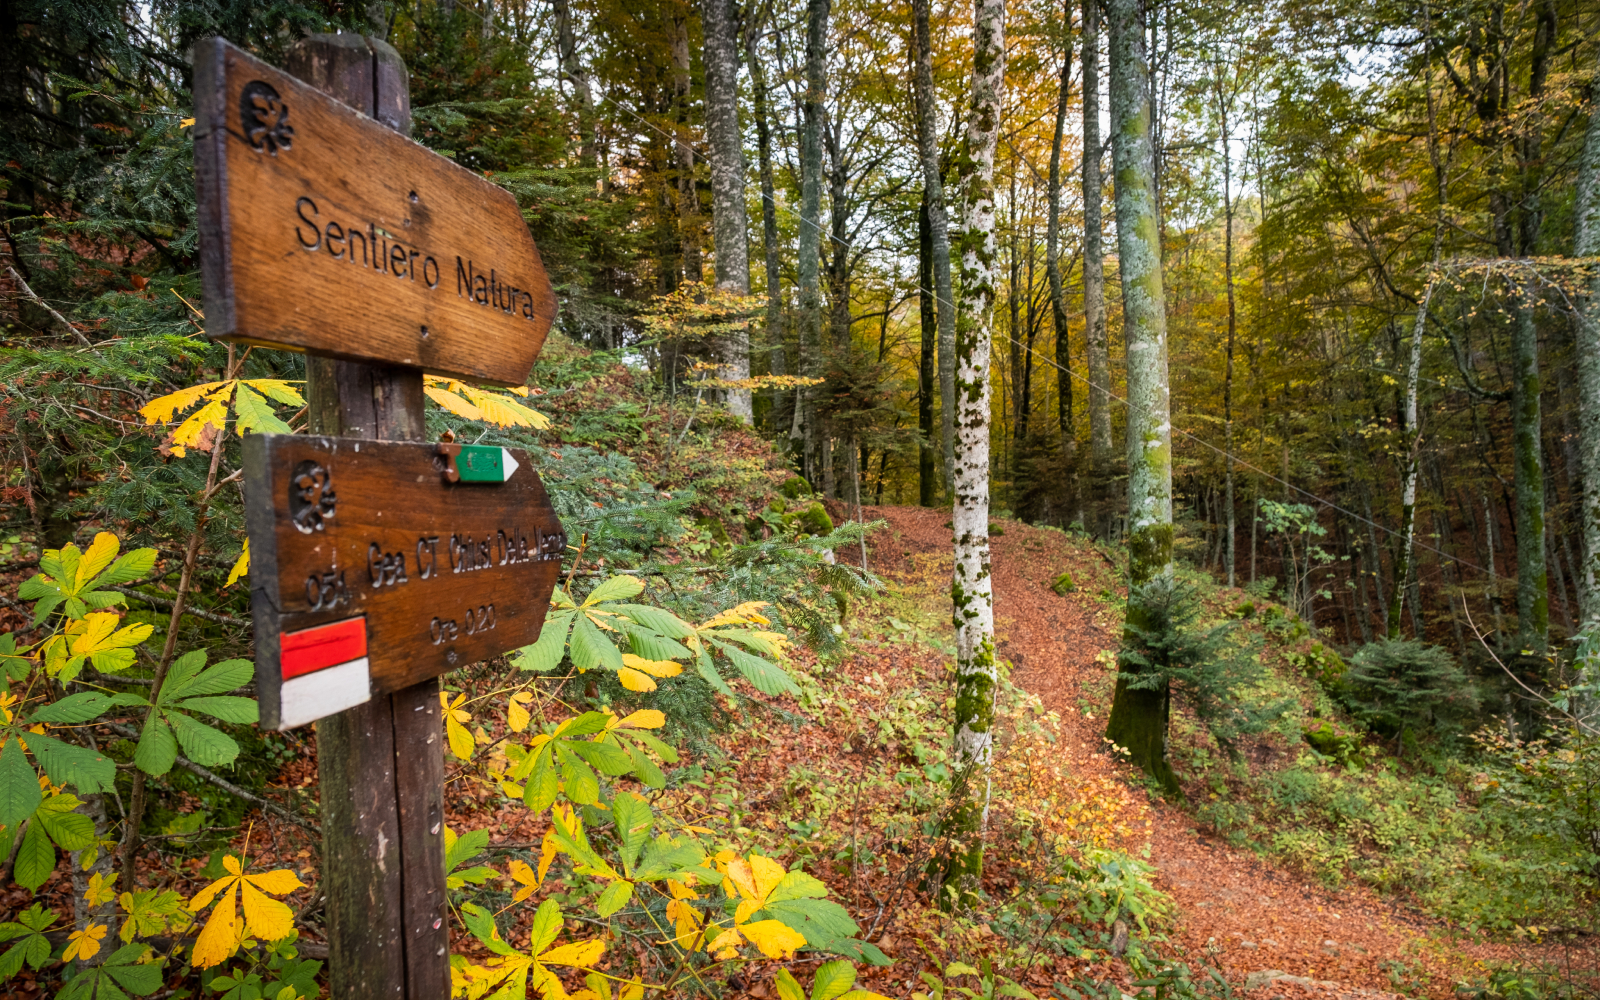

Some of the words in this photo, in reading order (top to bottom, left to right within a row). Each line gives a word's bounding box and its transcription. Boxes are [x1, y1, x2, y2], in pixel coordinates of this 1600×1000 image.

[295, 196, 440, 290] Sentiero
[456, 256, 535, 321] Natura
[367, 542, 408, 588] Gea
[416, 536, 440, 580] CT
[449, 533, 493, 573] Chiusi
[497, 527, 529, 566] Della
[430, 616, 458, 646] Ore
